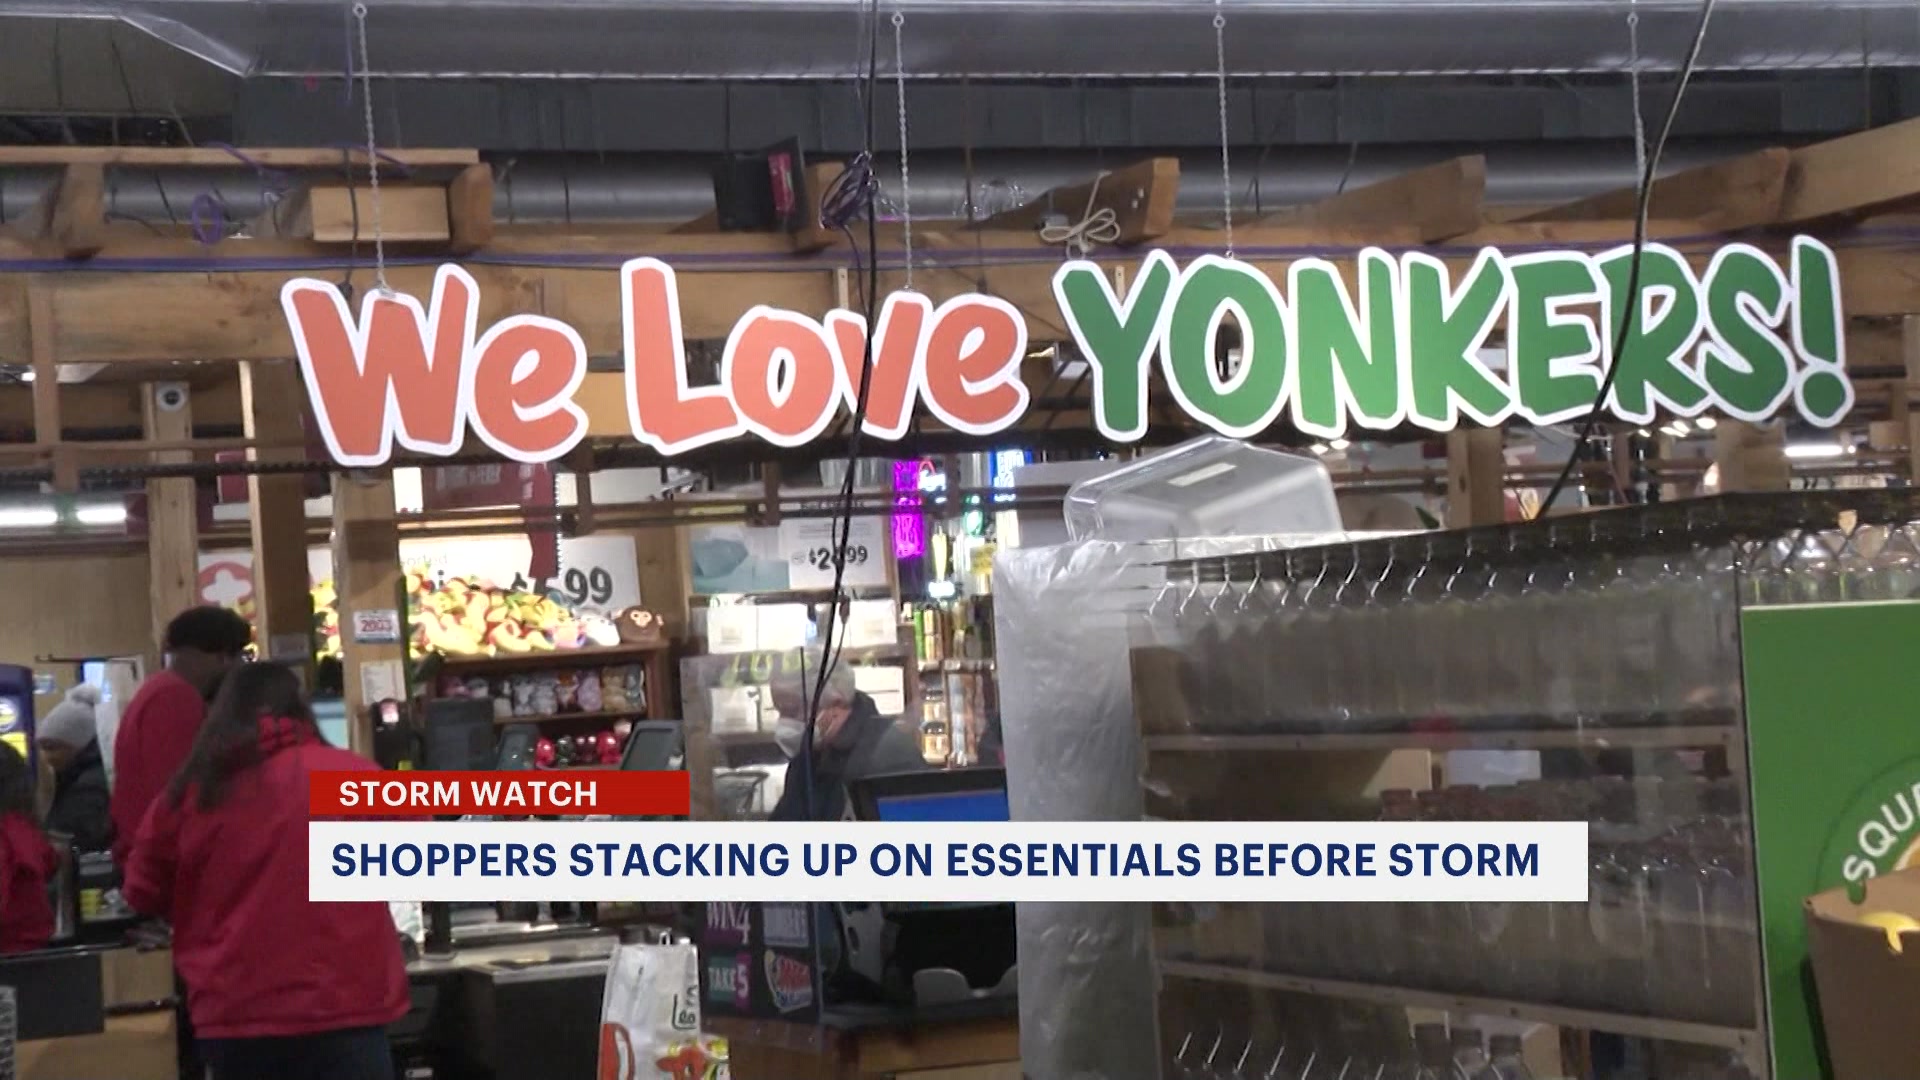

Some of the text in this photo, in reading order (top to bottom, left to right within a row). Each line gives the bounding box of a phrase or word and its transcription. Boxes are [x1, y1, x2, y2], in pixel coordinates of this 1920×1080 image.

[281, 235, 1854, 466] We Love YONKERS!
